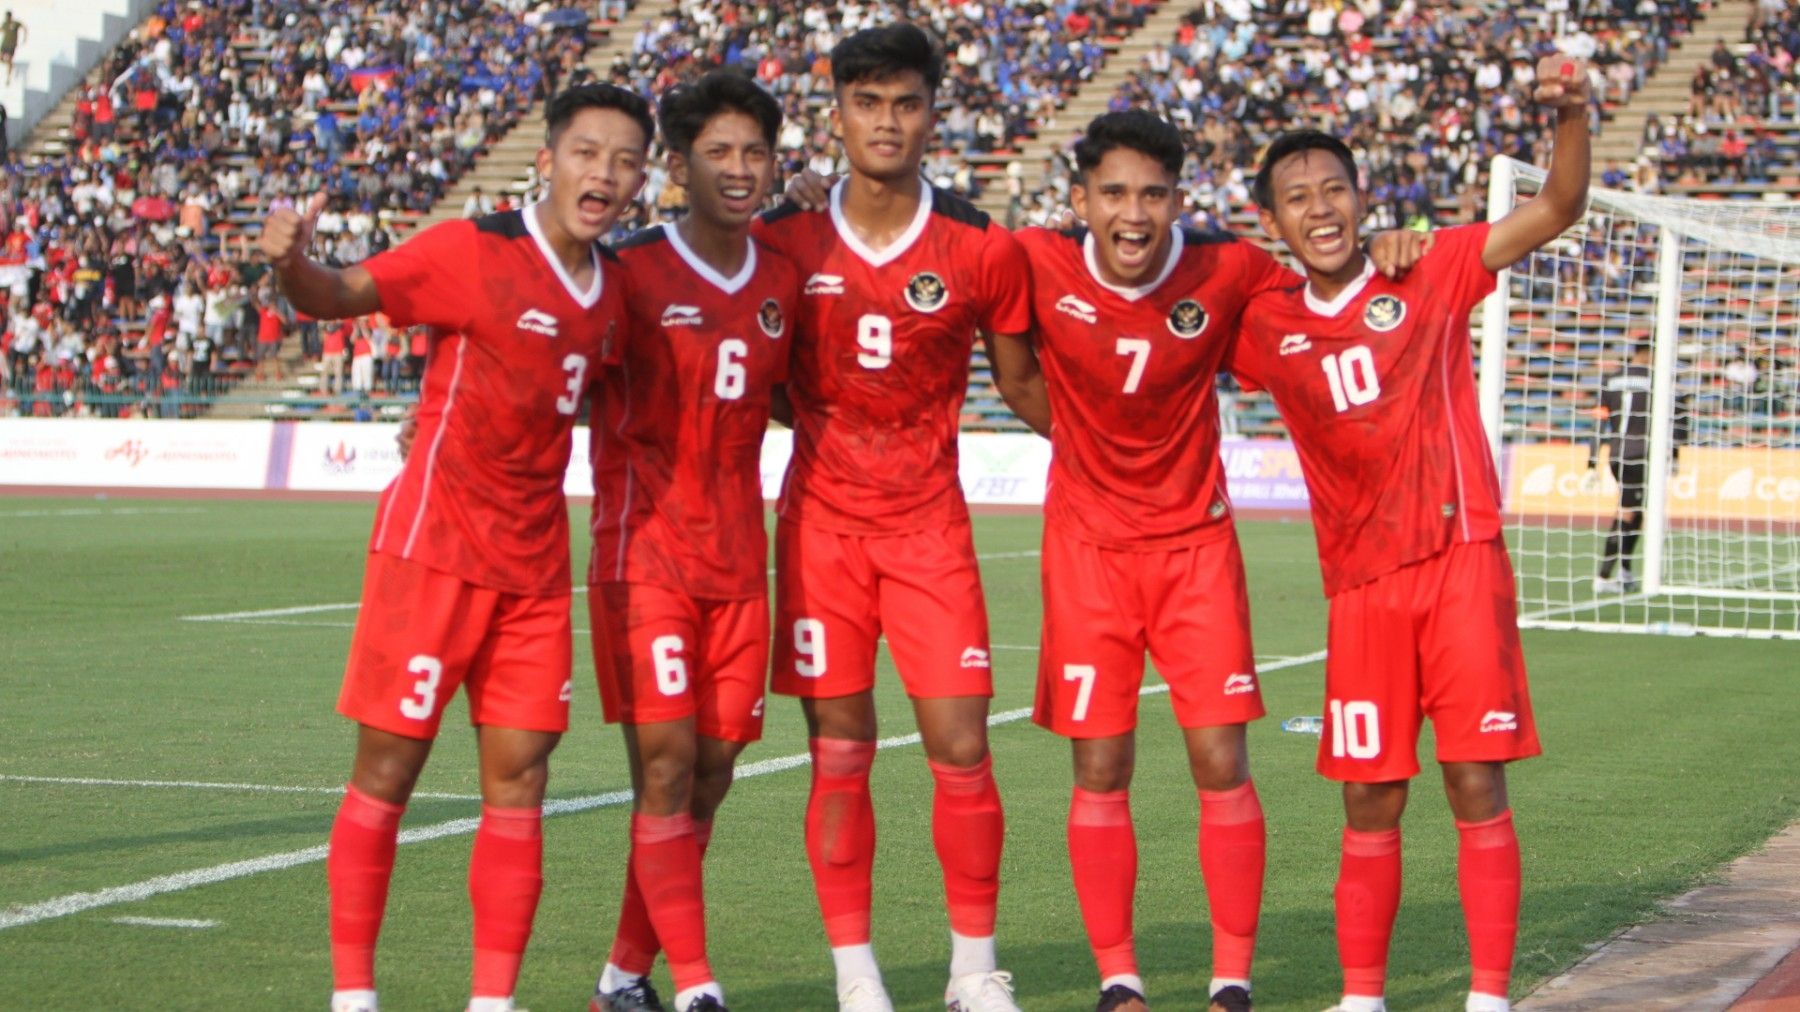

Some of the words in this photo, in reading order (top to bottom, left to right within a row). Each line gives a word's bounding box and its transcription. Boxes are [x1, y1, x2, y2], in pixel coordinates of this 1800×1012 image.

[714, 338, 748, 400] 6
[857, 314, 892, 369] 9
[1116, 337, 1151, 394] 7
[556, 353, 588, 415] 3
[1320, 344, 1381, 413] 10
[652, 634, 687, 696] 6
[793, 618, 827, 678] 9
[400, 654, 443, 720] 3
[1063, 663, 1096, 721] 7
[1330, 698, 1381, 759] 10
